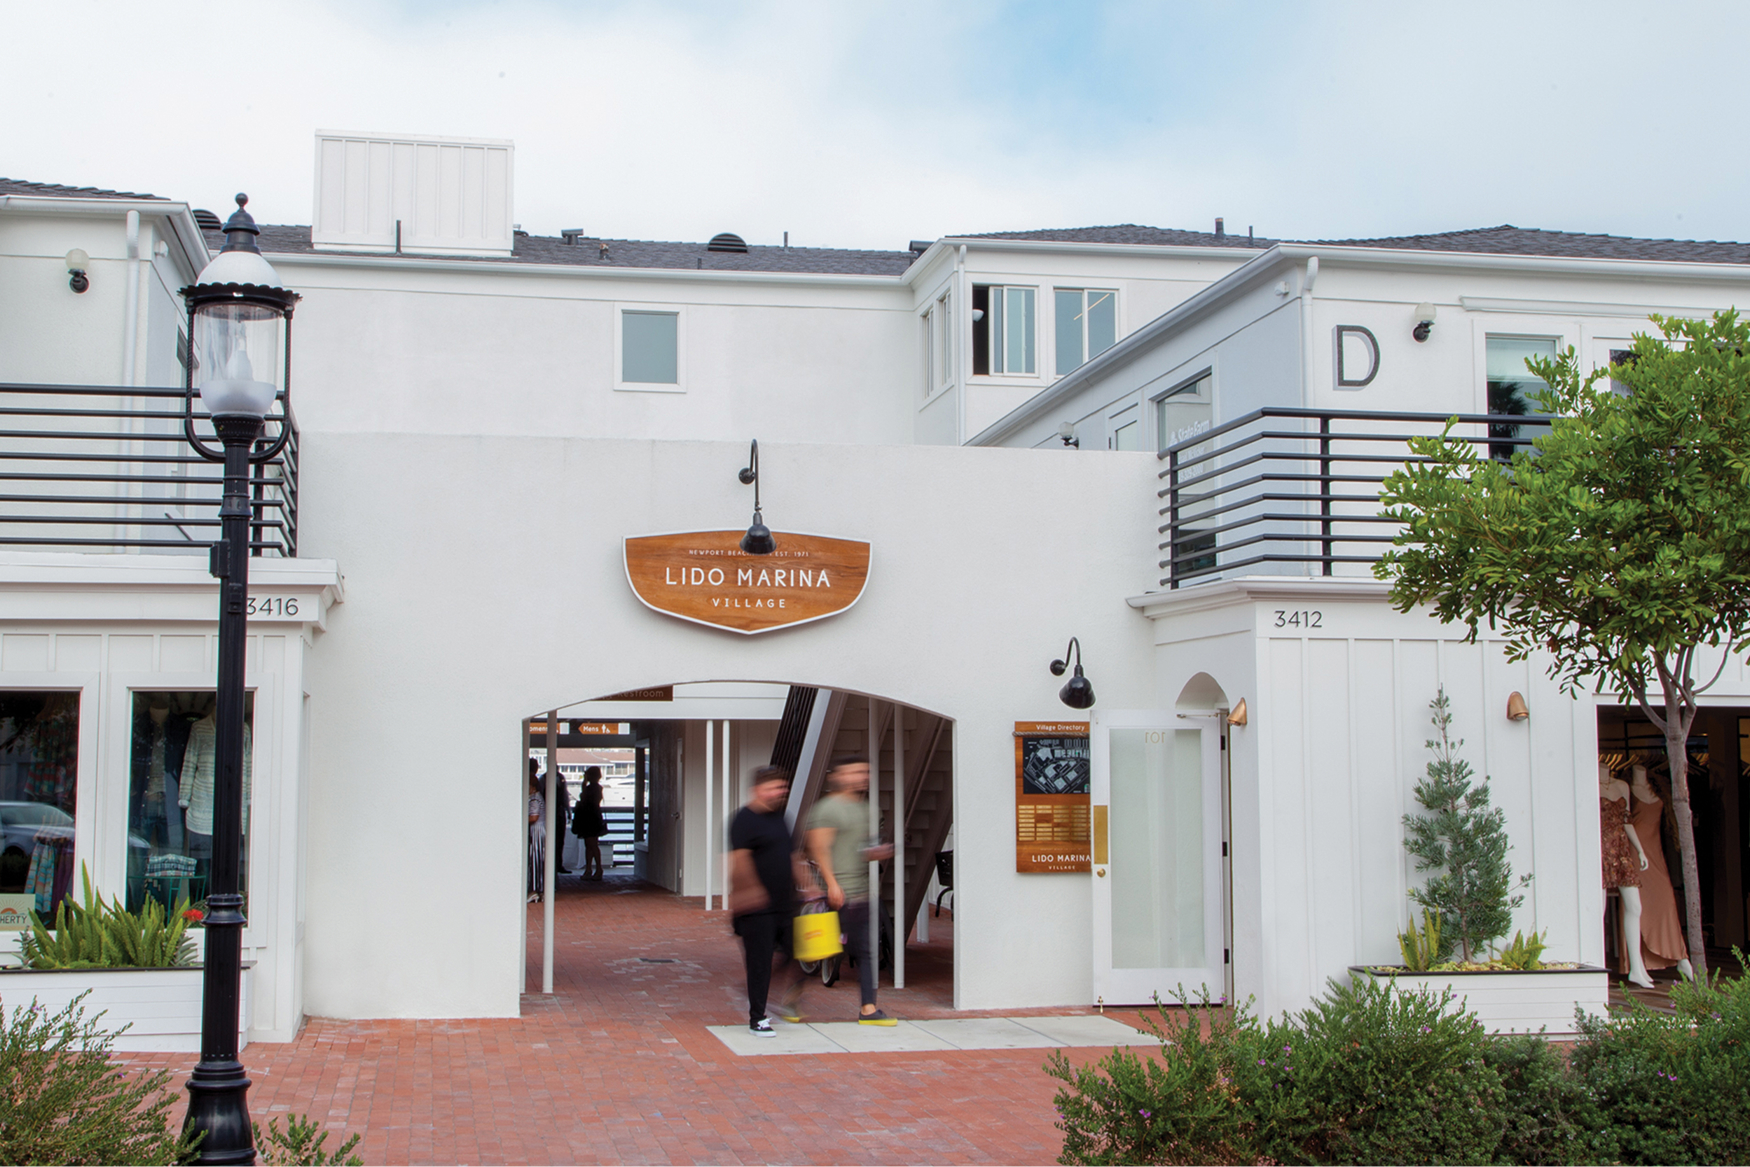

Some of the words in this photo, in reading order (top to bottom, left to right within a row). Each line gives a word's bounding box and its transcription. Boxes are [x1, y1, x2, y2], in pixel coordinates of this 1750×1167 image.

[1335, 324, 1380, 387] D
[665, 567, 725, 586] LIDO
[738, 568, 831, 588] MARINA
[246, 597, 299, 616] 3416
[712, 598, 786, 609] VILLAGE
[1274, 610, 1323, 628] 3412
[583, 725, 599, 733] Mens
[1032, 855, 1054, 863] LIDO
[1057, 854, 1091, 862] MARINA
